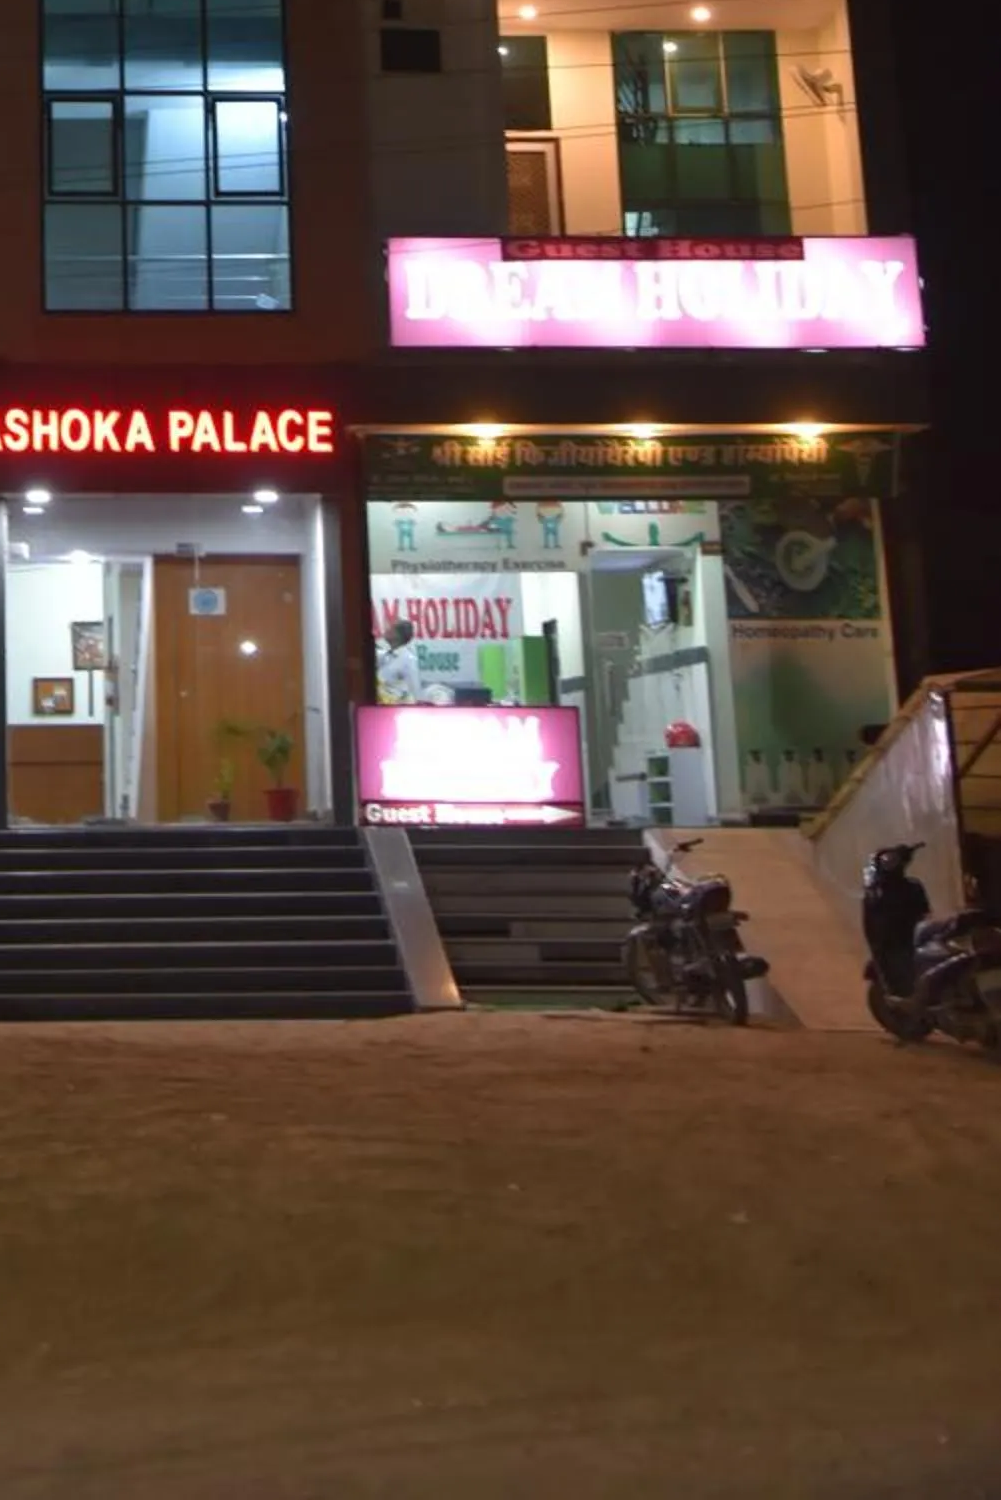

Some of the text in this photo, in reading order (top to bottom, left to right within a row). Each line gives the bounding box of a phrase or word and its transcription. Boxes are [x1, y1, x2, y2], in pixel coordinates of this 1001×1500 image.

[505, 238, 803, 258] Guest House
[635, 260, 904, 321] HOLIDAY
[168, 410, 333, 452] PALACE
[405, 596, 512, 640] HOLIDAY
[365, 803, 431, 824] Guest
